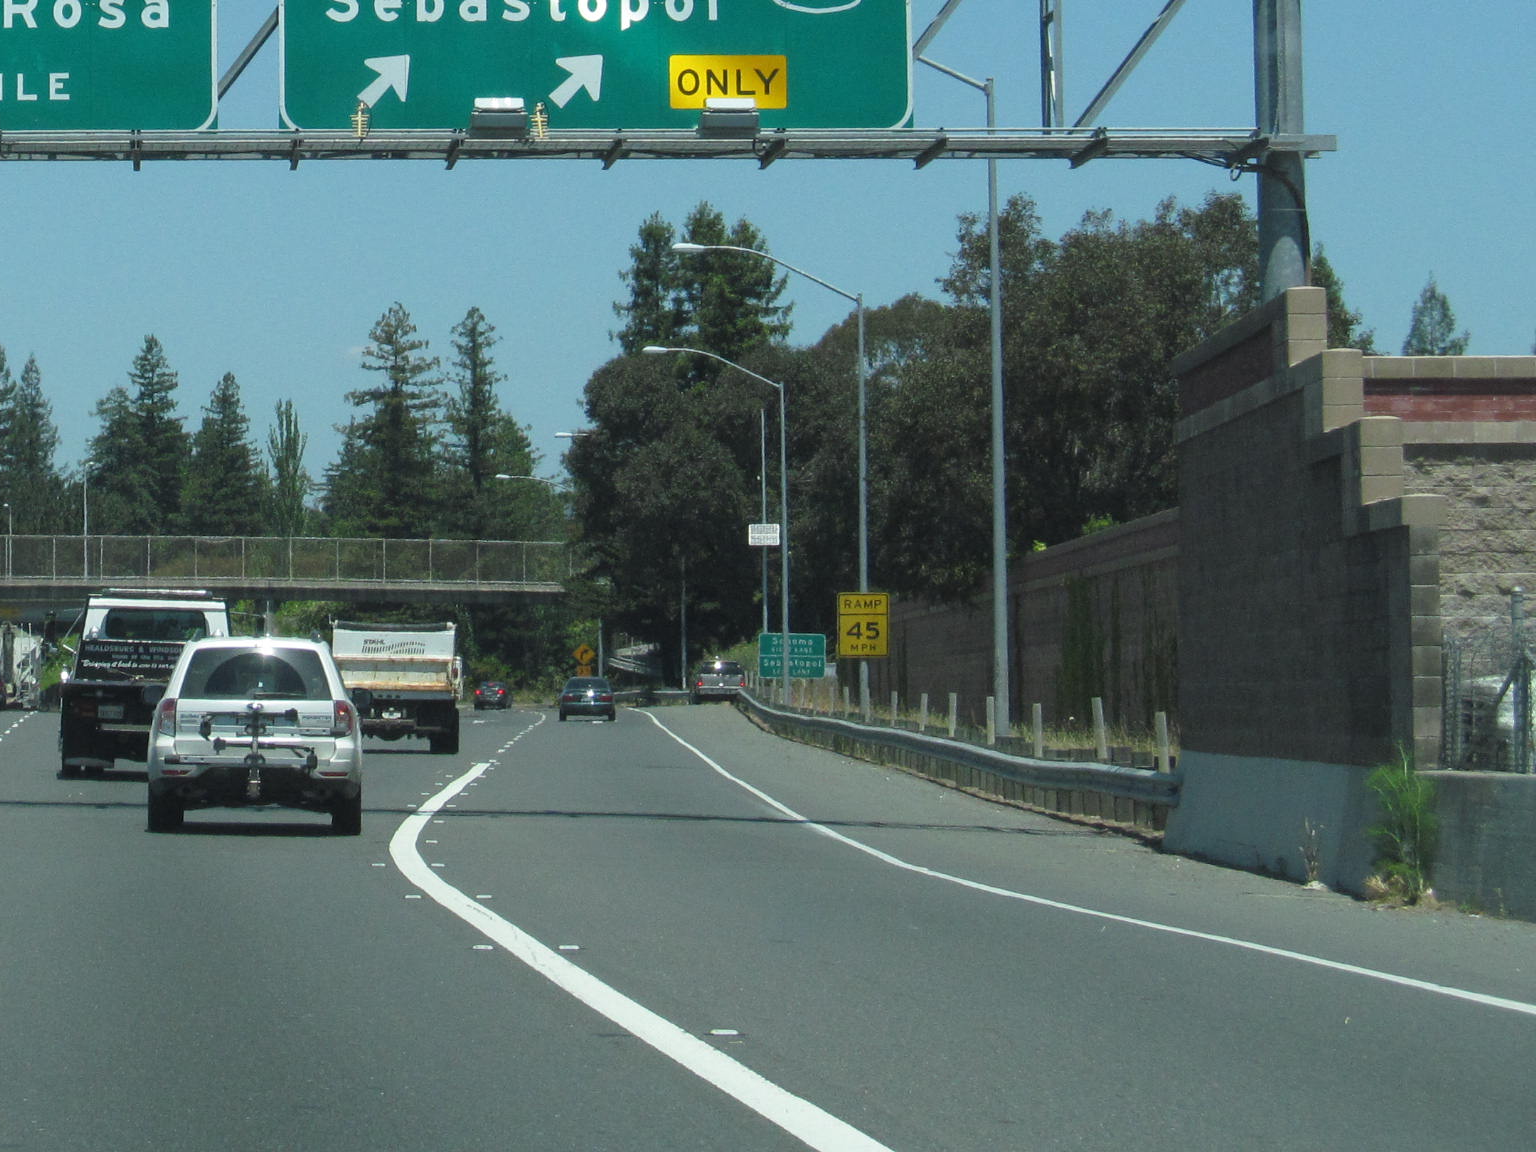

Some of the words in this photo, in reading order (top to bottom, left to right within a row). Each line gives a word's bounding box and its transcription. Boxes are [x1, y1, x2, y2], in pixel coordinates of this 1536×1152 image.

[677, 69, 780, 96] ONLY
[844, 599, 882, 609] RAMP
[846, 621, 880, 640] 45
[850, 644, 877, 652] MPH
